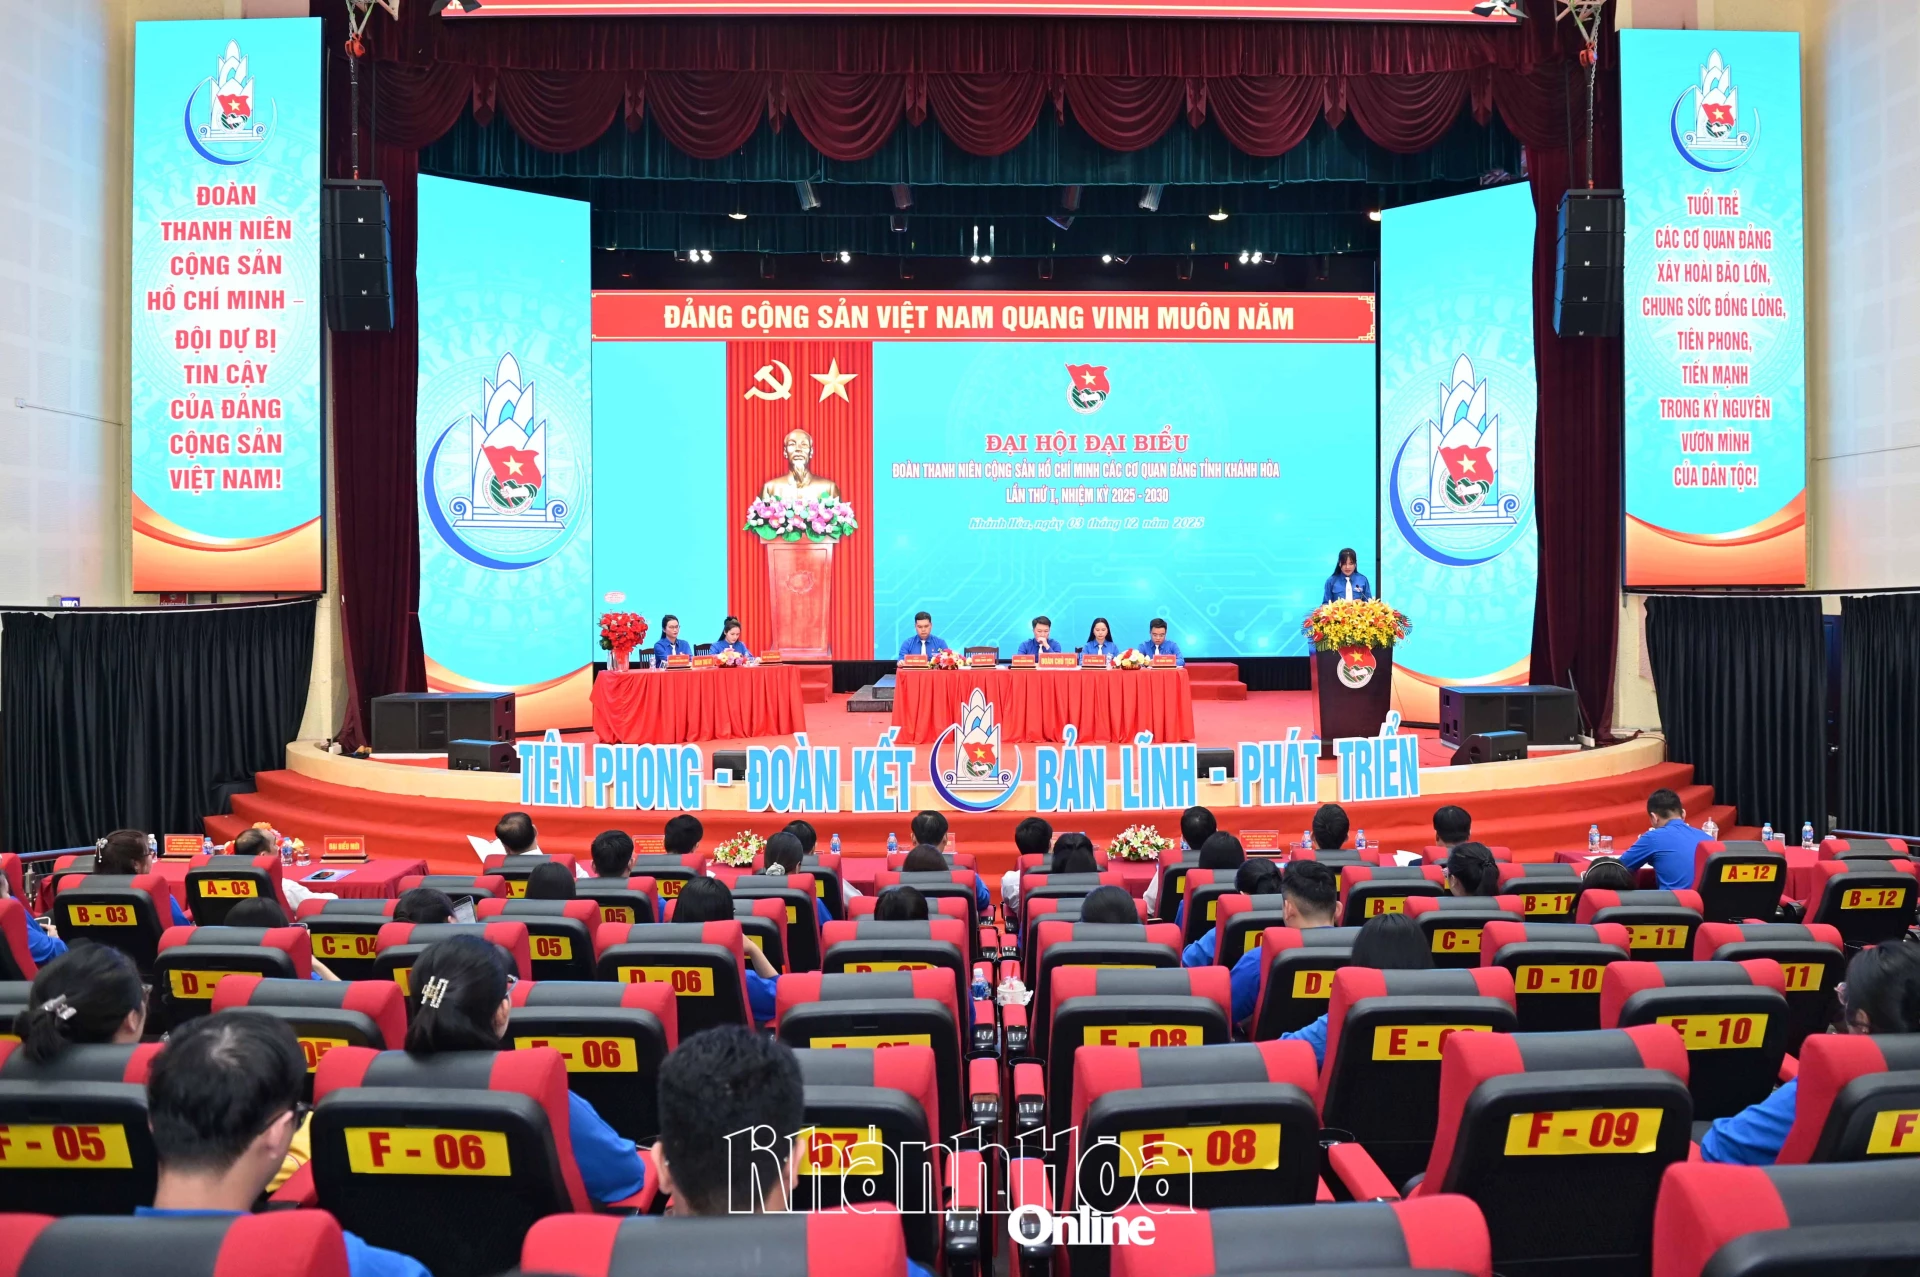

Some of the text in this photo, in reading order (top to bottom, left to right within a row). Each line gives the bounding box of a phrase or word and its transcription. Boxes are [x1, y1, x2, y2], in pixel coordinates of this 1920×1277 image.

[197, 181, 256, 206] ĐOÀN
[1687, 188, 1739, 215] TUỔI TRẺ
[161, 216, 291, 241] THANH NIÊN
[1655, 224, 1772, 251] CÁC CƠ QUAN ĐẢNG
[170, 248, 282, 280] CỘNG SẢN
[1657, 259, 1771, 285] XÂY HOÀI BÃO LỚN,
[147, 284, 176, 311] HỒ
[183, 286, 219, 311] CHÍ
[227, 290, 285, 310] MINH
[1642, 297, 1683, 316] CHUNG
[1687, 293, 1711, 316] SỨC
[1751, 293, 1786, 319] LÒNG,
[663, 297, 1294, 333] ĐẢNG CỘNG SẢN VIỆT NAM QUANG VINH MUÔN NĂM
[175, 325, 276, 354] ĐỘI DỰ BỊ
[1677, 327, 1752, 353] TIÊN PHONG,
[183, 359, 268, 389] TIN CẬY
[1682, 359, 1748, 388] TIẾN MẠNH
[170, 392, 281, 419] CỦA ĐẢNG
[1660, 393, 1770, 418] TRONG KỶ NGUYÊN
[170, 427, 282, 459] CỘNG SẢN
[985, 425, 1189, 455] ĐẠI HỘI ĐẠI BIỂU
[1681, 429, 1750, 452] VƯƠN MÌNH
[169, 465, 281, 493] VIỆT NAM!
[892, 459, 920, 478] ĐOÀN
[922, 462, 956, 478] THANH
[958, 460, 982, 478] NIÊN
[985, 459, 1012, 481] CỘNG
[1015, 458, 1036, 478] SẢN
[1054, 460, 1071, 478] CHÍ
[1073, 462, 1100, 478] MINH
[1102, 460, 1123, 478] CÁC
[1125, 461, 1139, 478] CƠ
[1141, 462, 1167, 480] QUAN
[1169, 458, 1197, 478] ĐẢNG
[1199, 458, 1222, 478] TỈNH
[1224, 459, 1258, 478] KHÁNH
[1260, 459, 1280, 478] HÒA
[1674, 460, 1757, 490] CỦA DÂN TỘC!
[1028, 484, 1049, 503] THỨ
[1049, 487, 1059, 505] I,
[1061, 484, 1094, 506] NHIỆM
[1096, 484, 1110, 503] KỲ
[1111, 487, 1136, 503] 2025
[1144, 487, 1169, 503] 2030
[969, 517, 1007, 529] Khánh
[1034, 518, 1063, 531] ngày
[1067, 517, 1084, 529] 03
[1087, 517, 1121, 531] tháng
[1124, 517, 1139, 528] 12
[1142, 517, 1169, 528] năm
[1172, 517, 1204, 529] 2025
[516, 728, 704, 811] TIÊN PHONG
[745, 725, 916, 813] ĐOÀN KẾT
[1035, 724, 1198, 812] BẢN LĨNH
[1237, 709, 1420, 807] PHÁT TRIỂN
[1754, 866, 1770, 879] 12
[231, 881, 250, 895] 03
[1878, 890, 1897, 905] 12
[105, 906, 128, 923] 03
[536, 937, 562, 957] 05
[671, 969, 702, 993] 06
[1569, 968, 1598, 990] 10
[1718, 1017, 1753, 1045] 10
[582, 1040, 621, 1068] 06
[52, 1125, 106, 1162] 05
[1527, 1112, 1553, 1149] F
[1588, 1112, 1639, 1148] 09
[368, 1132, 391, 1167] F
[433, 1134, 486, 1170] 06
[1206, 1129, 1256, 1166] 08
